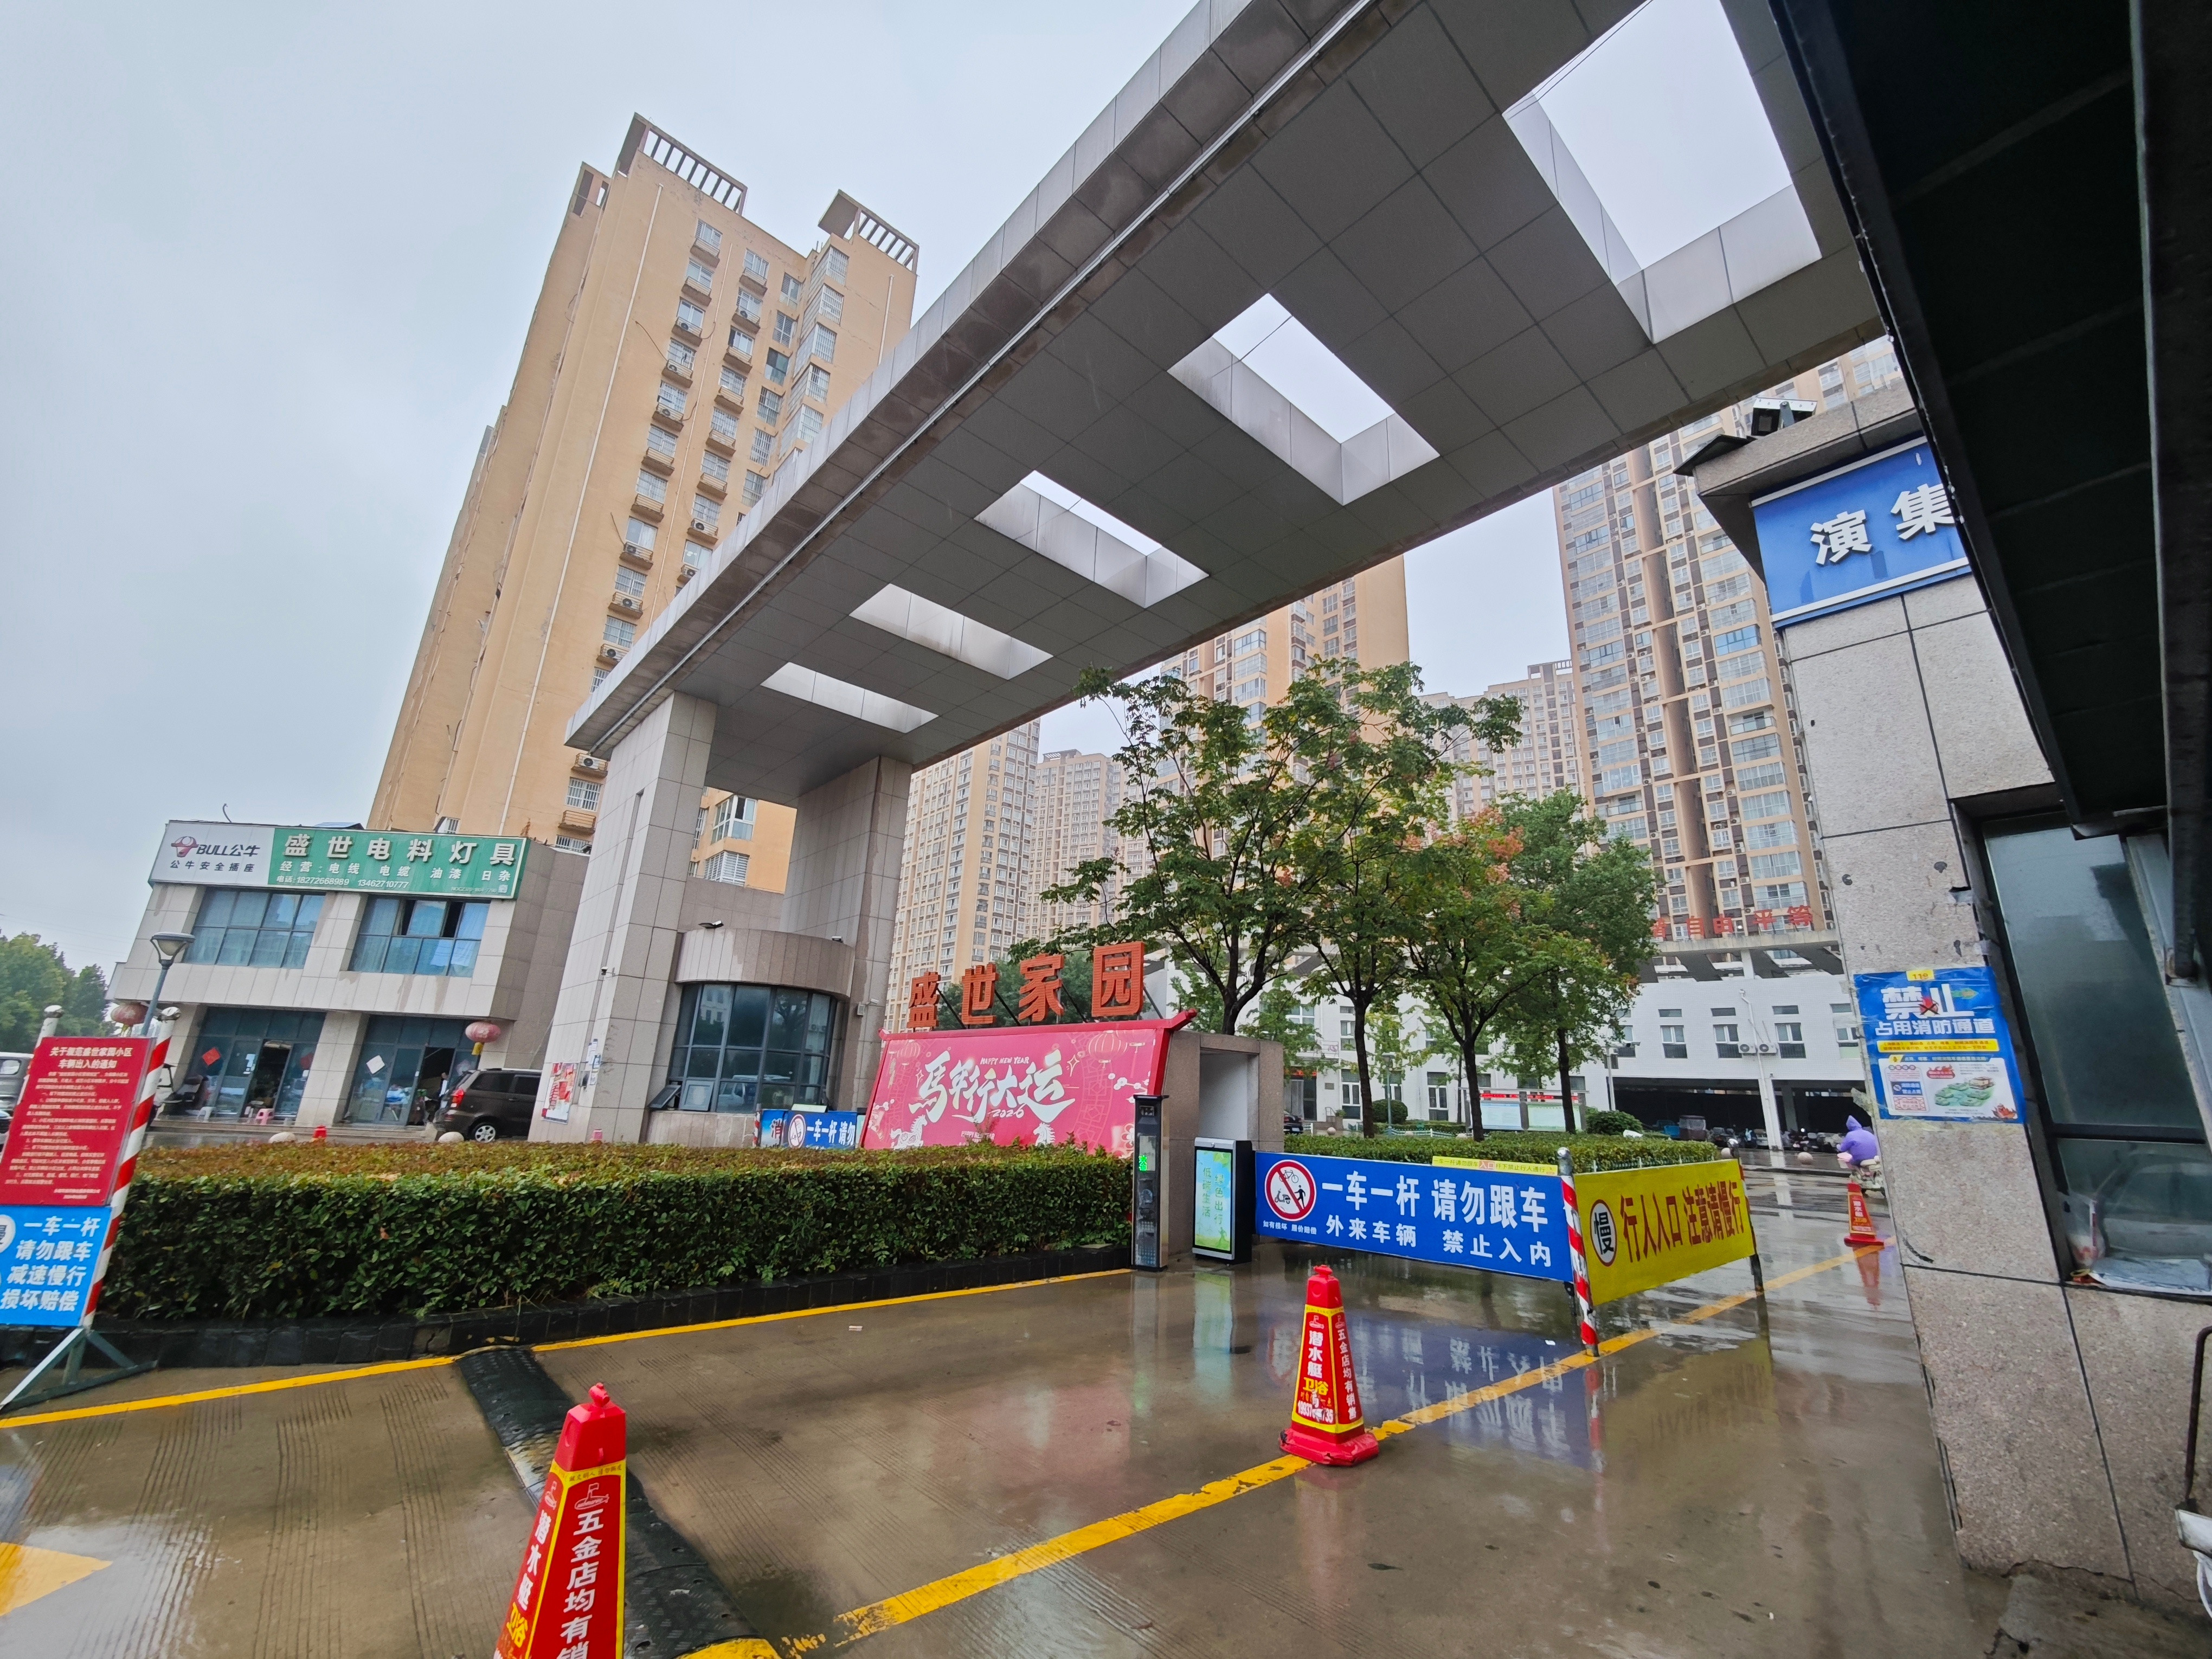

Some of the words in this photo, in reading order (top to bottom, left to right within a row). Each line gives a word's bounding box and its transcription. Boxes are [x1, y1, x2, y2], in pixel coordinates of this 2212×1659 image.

[1810, 483, 1955, 565] 演集
[284, 834, 517, 866] 盛世电料灯具
[170, 860, 255, 872] 公牛安全插座
[380, 865, 411, 877] 电缆
[430, 867, 462, 879] 油漆
[481, 870, 511, 882] 日杂
[907, 942, 1145, 1029] 盛世家园
[1881, 983, 1975, 1020] 禁止
[1875, 1018, 1996, 1036] 占用消防通道
[988, 1105, 1024, 1117] 2026
[807, 1119, 838, 1144] 一车一杆
[1322, 1171, 1420, 1217] 一车一杆
[1431, 1179, 1548, 1233] 请勿跟车
[24, 1216, 101, 1237] 一车一杆
[1593, 1211, 1614, 1255] 慢
[15, 1240, 94, 1262] 请勿跟车
[1326, 1215, 1417, 1248] 外来车辆
[1442, 1230, 1551, 1267] 禁止入内
[7, 1264, 87, 1287] 减速慢行
[0, 1289, 80, 1311] 损坏赔偿
[1307, 1330, 1323, 1379] 潜水艇
[1302, 1377, 1329, 1396] 卫浴
[1338, 1328, 1357, 1420] 五金店均有销售
